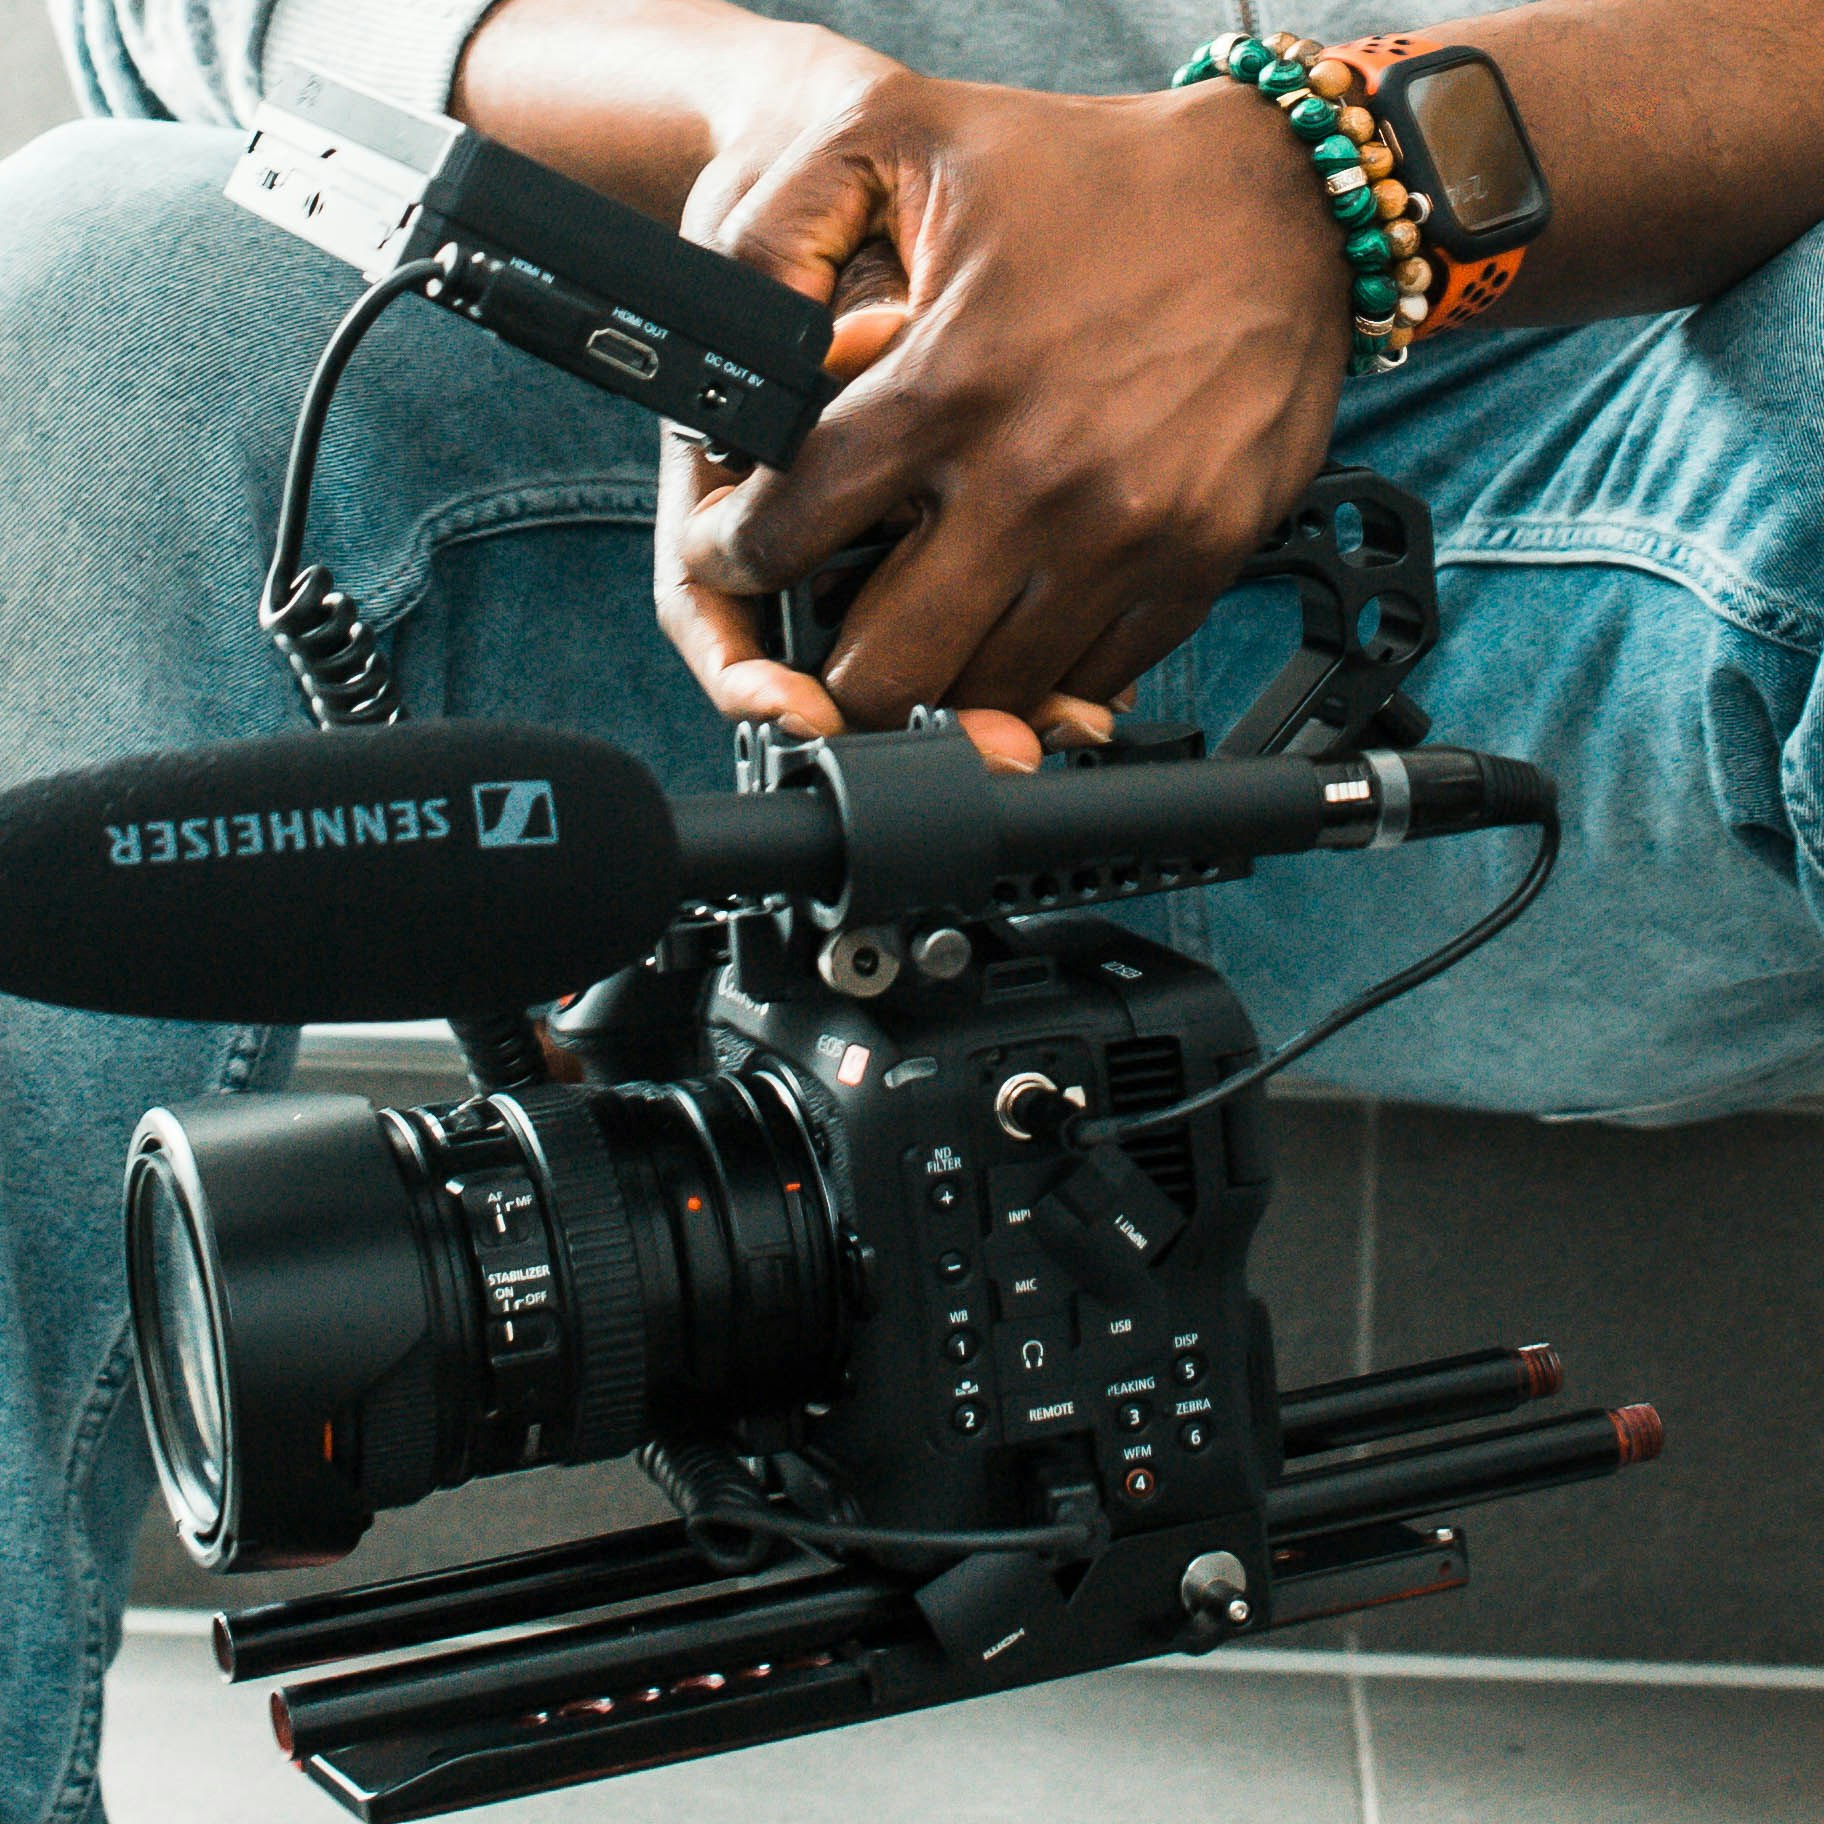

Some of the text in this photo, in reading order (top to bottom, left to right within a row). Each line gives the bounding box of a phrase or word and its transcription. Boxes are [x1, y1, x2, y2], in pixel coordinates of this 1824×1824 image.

[612, 307, 668, 339] HDMI OUT
[705, 352, 723, 367] DC
[723, 362, 748, 379] OUT
[105, 799, 451, 865] SENNHEISER
[817, 1034, 846, 1058] EOS
[934, 1147, 952, 1160] ND
[927, 1156, 962, 1173] FILTER
[488, 1191, 503, 1203] AF
[516, 1195, 532, 1207] MF
[1120, 1219, 1148, 1249] INPUT
[488, 1265, 550, 1286] STABILIZER
[495, 1286, 514, 1300] ON
[1016, 1279, 1037, 1293] MIC
[525, 1291, 546, 1305] OFF
[950, 1310, 968, 1323] WB
[1111, 1319, 1131, 1334] USB
[958, 1341, 964, 1355] 1
[1175, 1333, 1198, 1348] DISP
[1186, 1363, 1194, 1378] 5
[1108, 1377, 1155, 1396] PEAKING
[1030, 1402, 1074, 1421] REMOTE
[1176, 1398, 1211, 1415] ZEBRA
[965, 1412, 974, 1427] 2
[1130, 1409, 1139, 1424] 3
[1191, 1430, 1200, 1444] 6
[1124, 1445, 1151, 1460] WFM
[1135, 1475, 1145, 1489] 4
